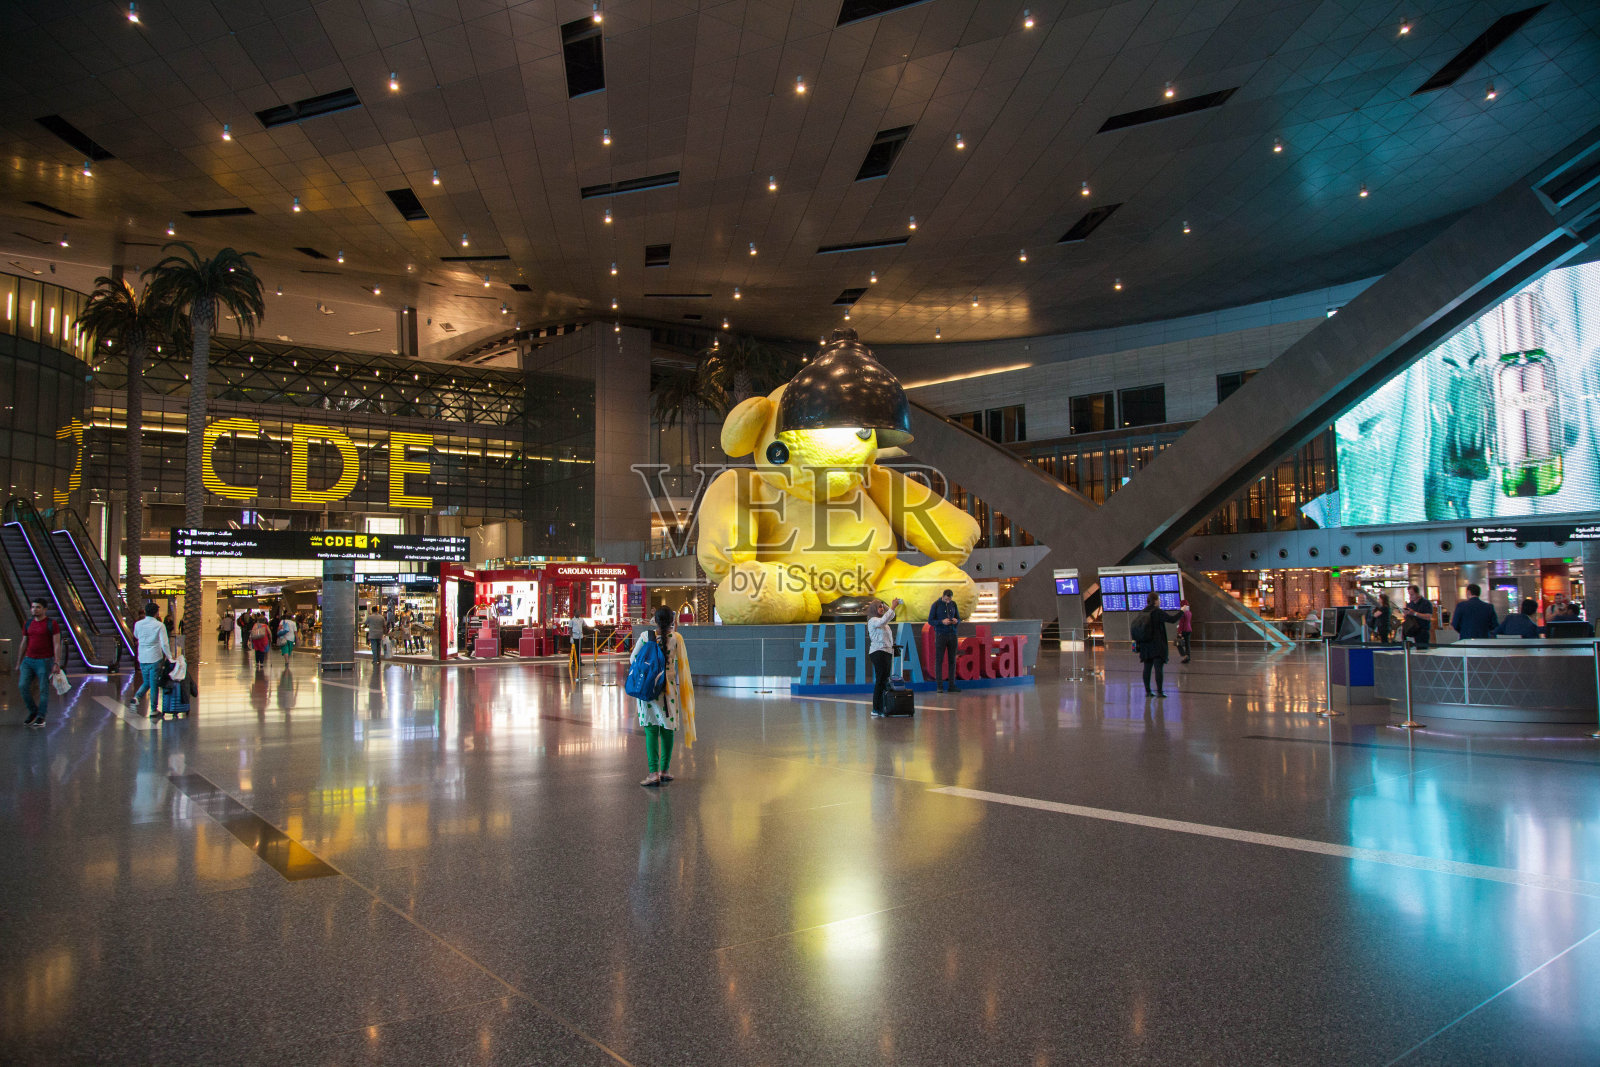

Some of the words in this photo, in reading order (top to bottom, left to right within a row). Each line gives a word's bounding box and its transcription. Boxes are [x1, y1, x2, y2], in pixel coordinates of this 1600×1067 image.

[325, 535, 353, 547] CDE
[557, 567, 593, 575] CAROLINA
[594, 568, 627, 576] HERRERA
